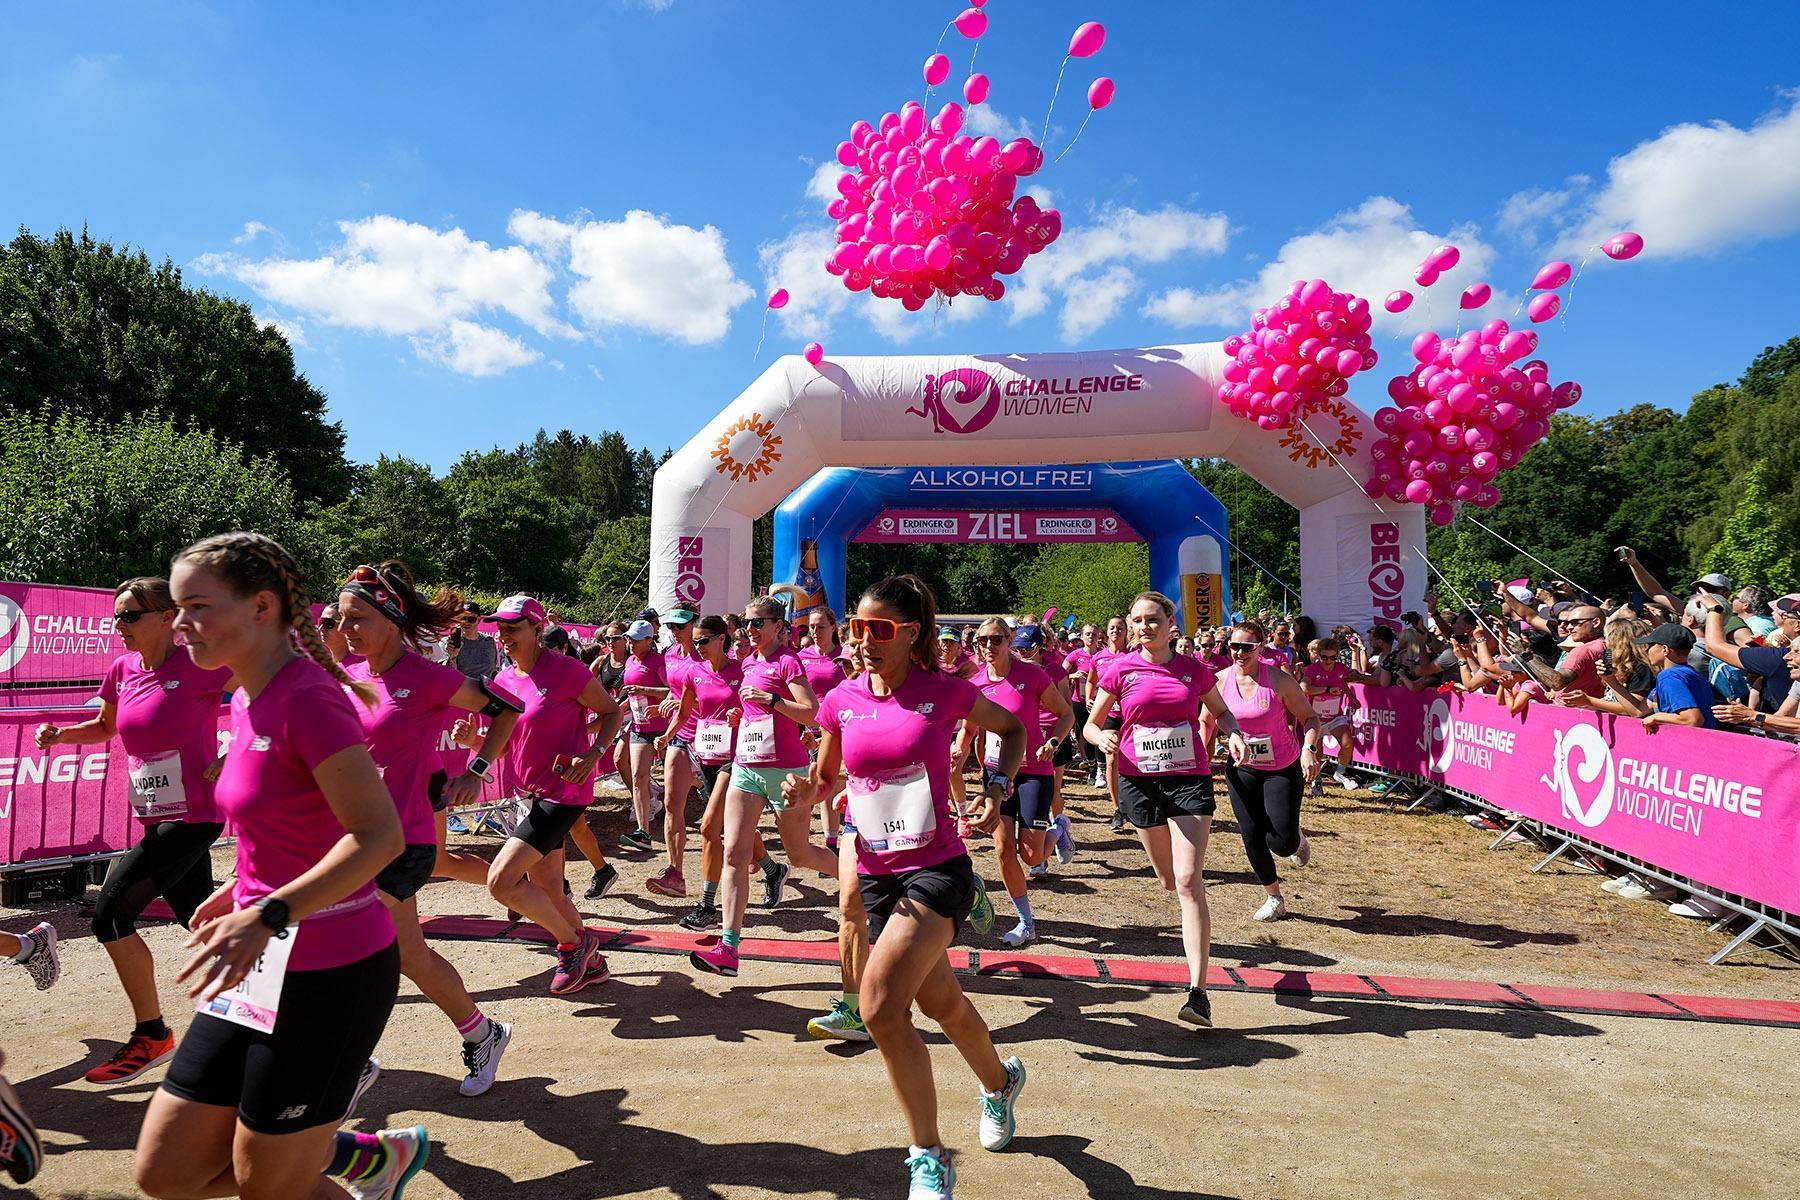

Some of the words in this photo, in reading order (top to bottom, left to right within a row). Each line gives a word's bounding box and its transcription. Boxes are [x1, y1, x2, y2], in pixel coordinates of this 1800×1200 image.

[1004, 374, 1143, 396] CHALLENGE
[1003, 396, 1092, 416] WOMEN
[910, 470, 1092, 486] ALKOHOLFREI
[903, 519, 945, 529] ERDINGER
[968, 513, 1027, 539] ZIEL
[1040, 519, 1082, 529] ERDINGER
[33, 636, 110, 654] WOMEN
[1142, 737, 1186, 751] MICHELLE
[1454, 720, 1516, 755] CHALLENGE
[1160, 752, 1173, 761] 560
[1454, 741, 1493, 771] WOMEN
[1617, 757, 1763, 819] CHALLENGE
[1616, 786, 1703, 837] WOMEN
[883, 819, 905, 834] 1541
[895, 836, 930, 847] GARMIN
